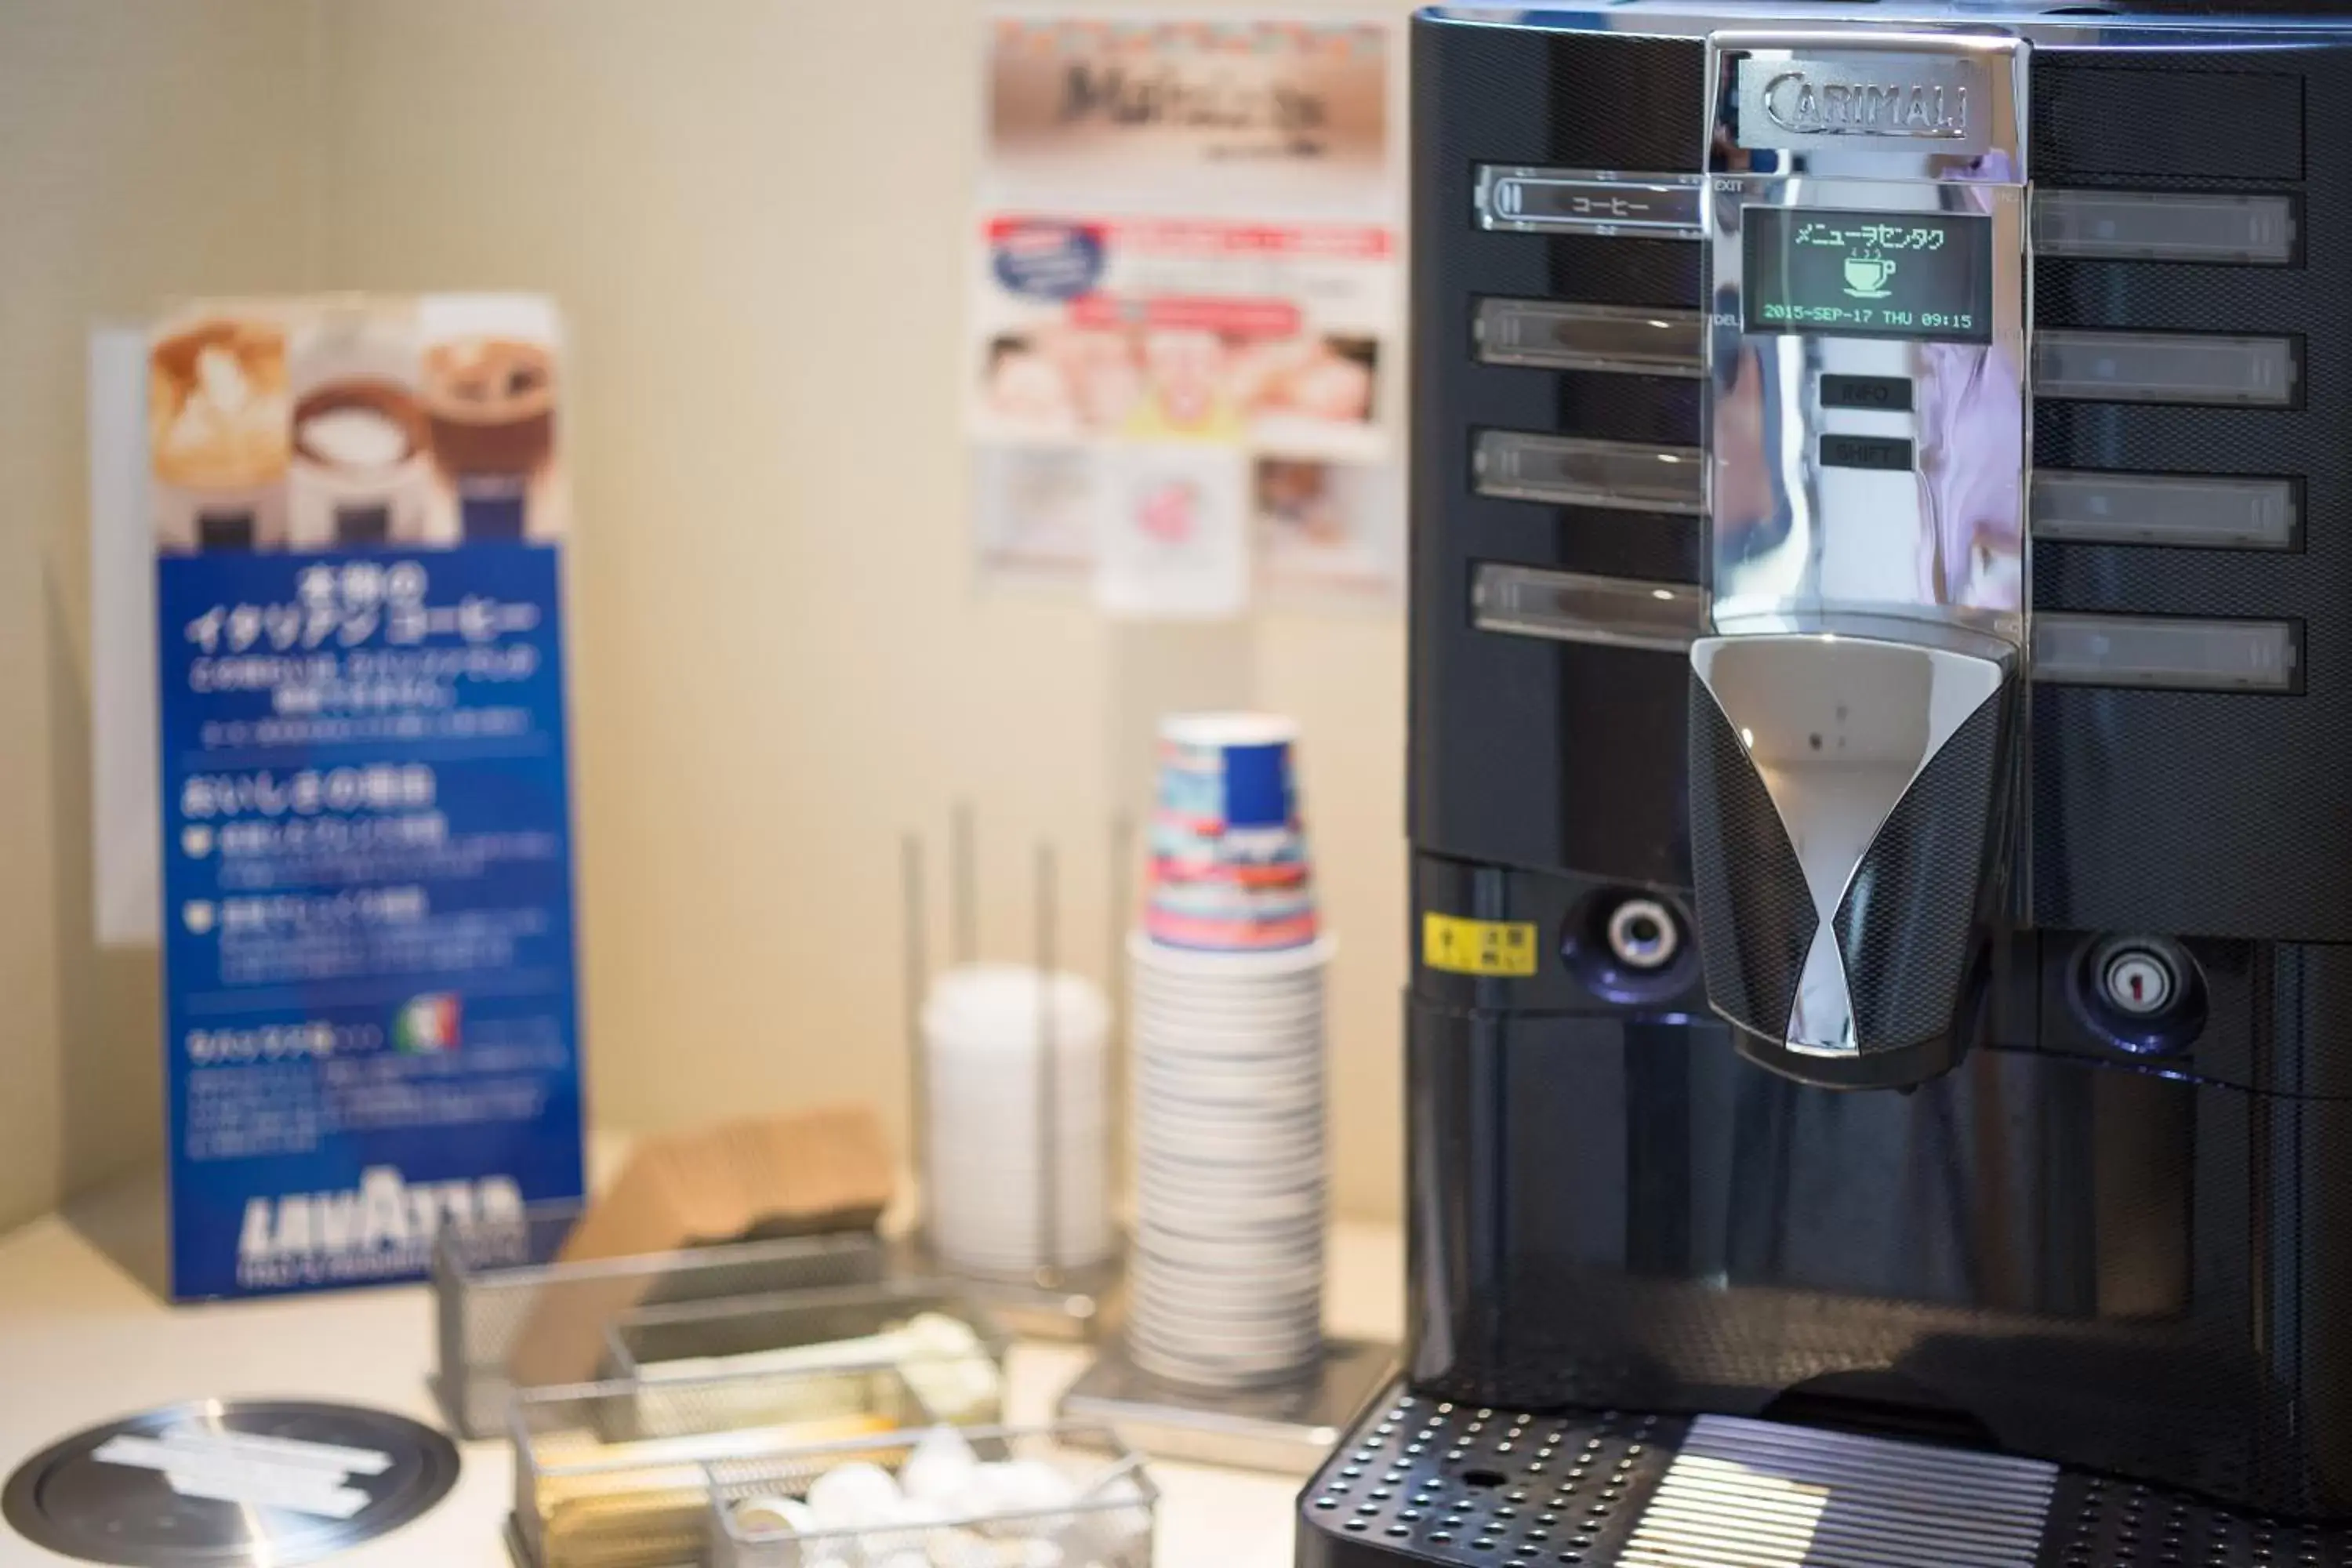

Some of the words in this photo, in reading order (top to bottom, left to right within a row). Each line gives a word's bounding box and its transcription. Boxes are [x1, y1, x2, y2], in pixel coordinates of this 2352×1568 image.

[1764, 72, 1966, 139] CARIMALI
[1714, 180, 1744, 192] EXIT
[1573, 197, 1650, 216] コーヒー
[1764, 305, 1873, 324] 2015-SEP-17
[1883, 310, 1913, 325] THU
[1922, 313, 1973, 328] 09:15
